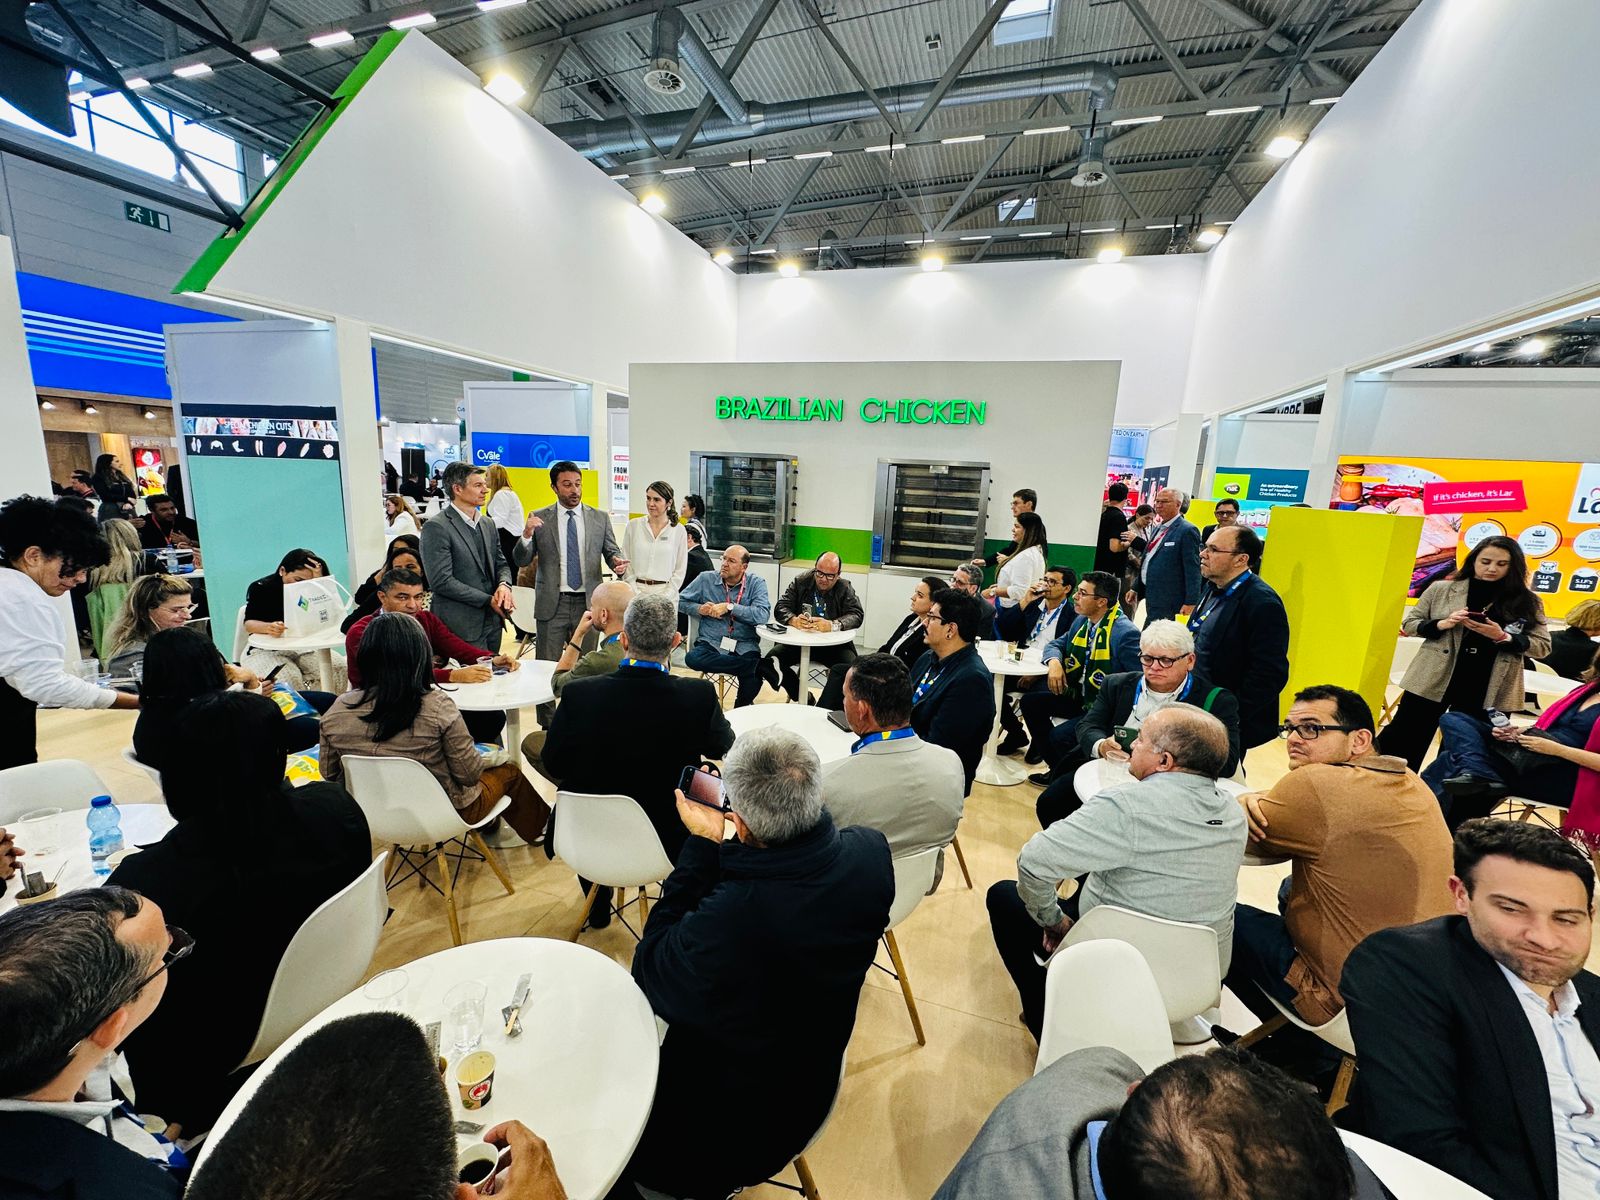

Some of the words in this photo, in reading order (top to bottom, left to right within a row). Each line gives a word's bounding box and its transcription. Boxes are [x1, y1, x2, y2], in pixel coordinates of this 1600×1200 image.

[715, 397, 843, 422] BRAZILIAN
[859, 398, 986, 425] CHICKEN
[275, 422, 292, 430] CUTS
[613, 466, 627, 474] FROM
[613, 482, 623, 490] THE
[1433, 493, 1439, 501] If
[1452, 490, 1485, 500] chicken,
[1499, 489, 1514, 497] Lar
